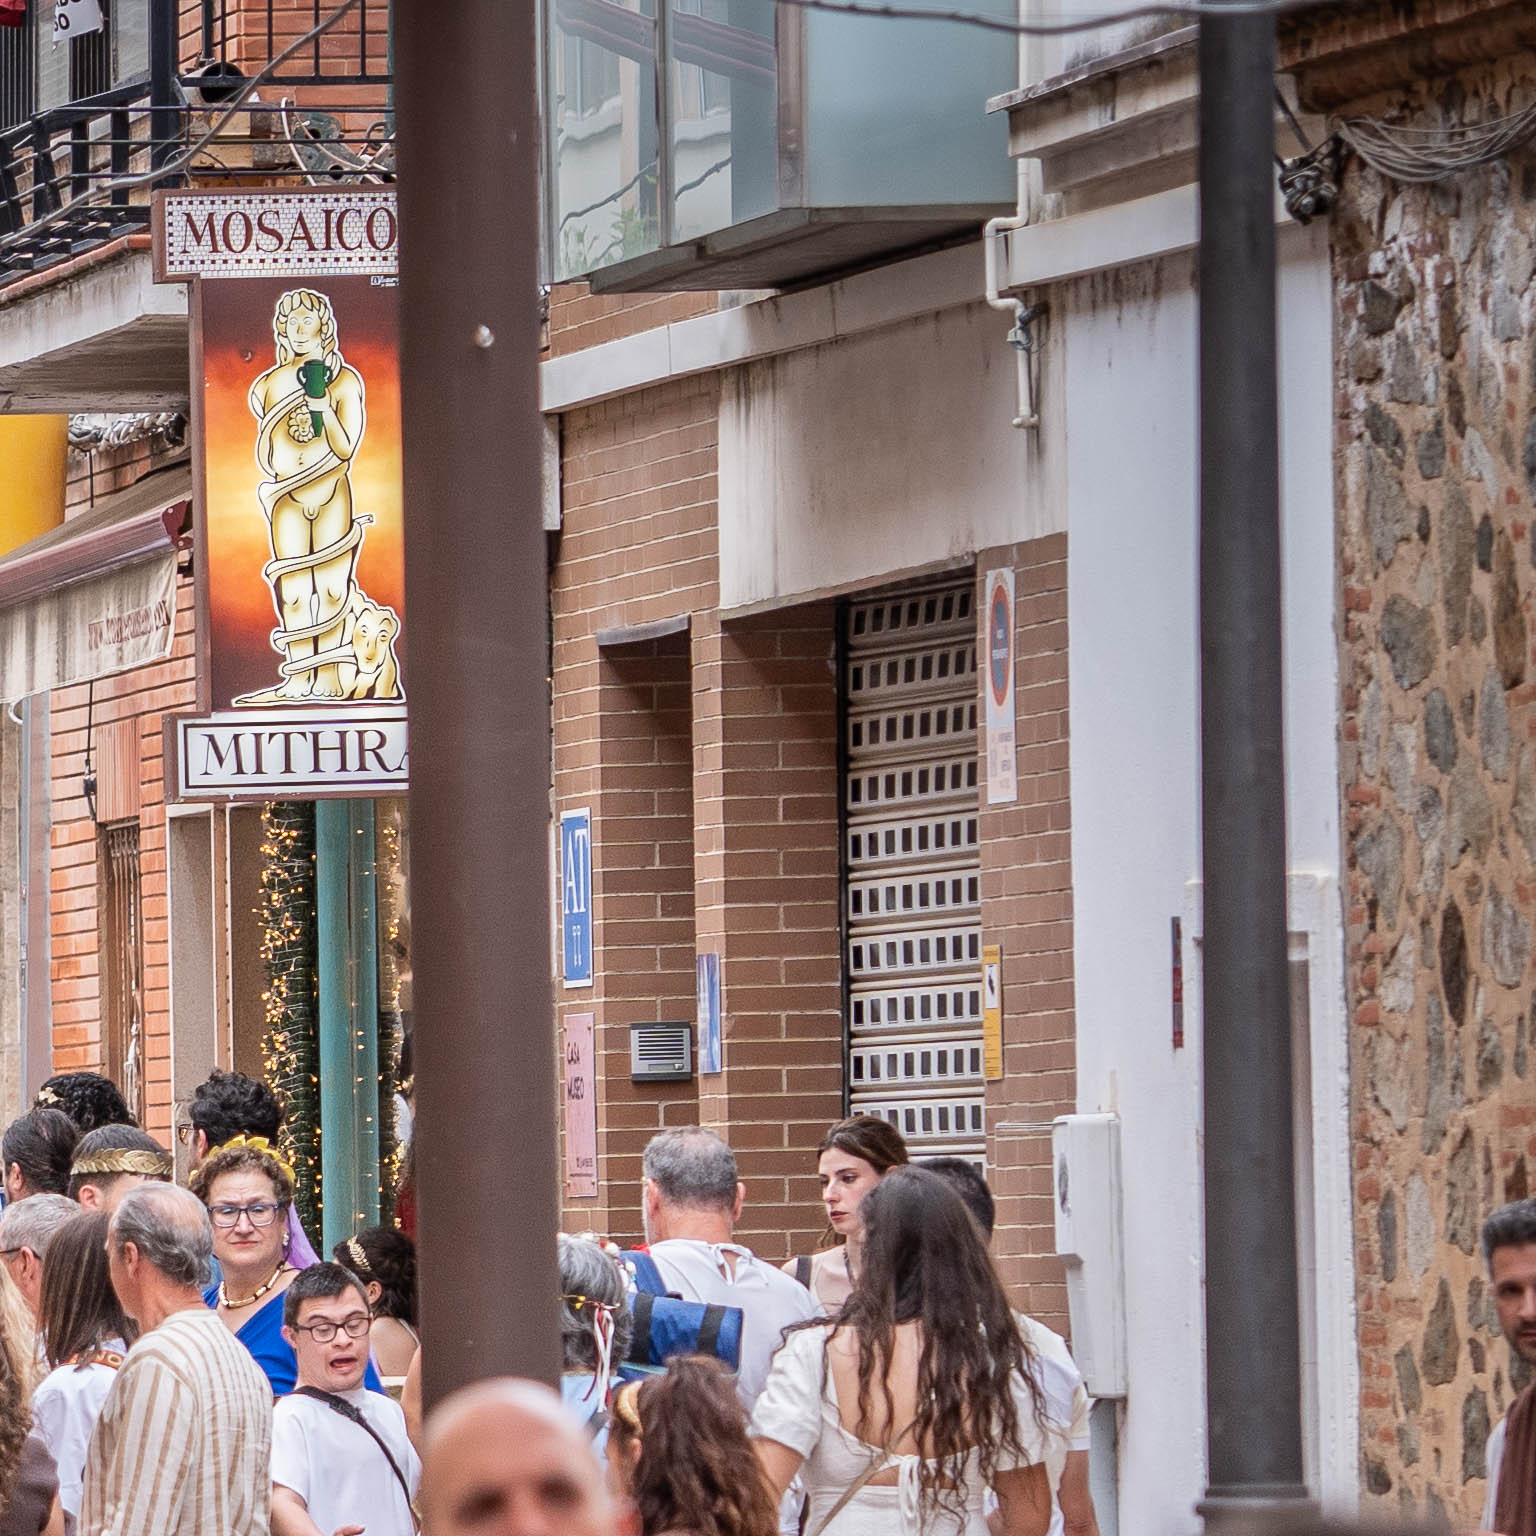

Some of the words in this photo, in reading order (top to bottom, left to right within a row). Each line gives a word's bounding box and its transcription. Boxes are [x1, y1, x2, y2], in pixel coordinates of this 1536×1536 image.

[180, 205, 397, 255] MOSAICO
[200, 730, 408, 776] MITHR
[564, 828, 588, 914] AT
[567, 1042, 581, 1065] CASA
[567, 1077, 585, 1101] MUSEO
